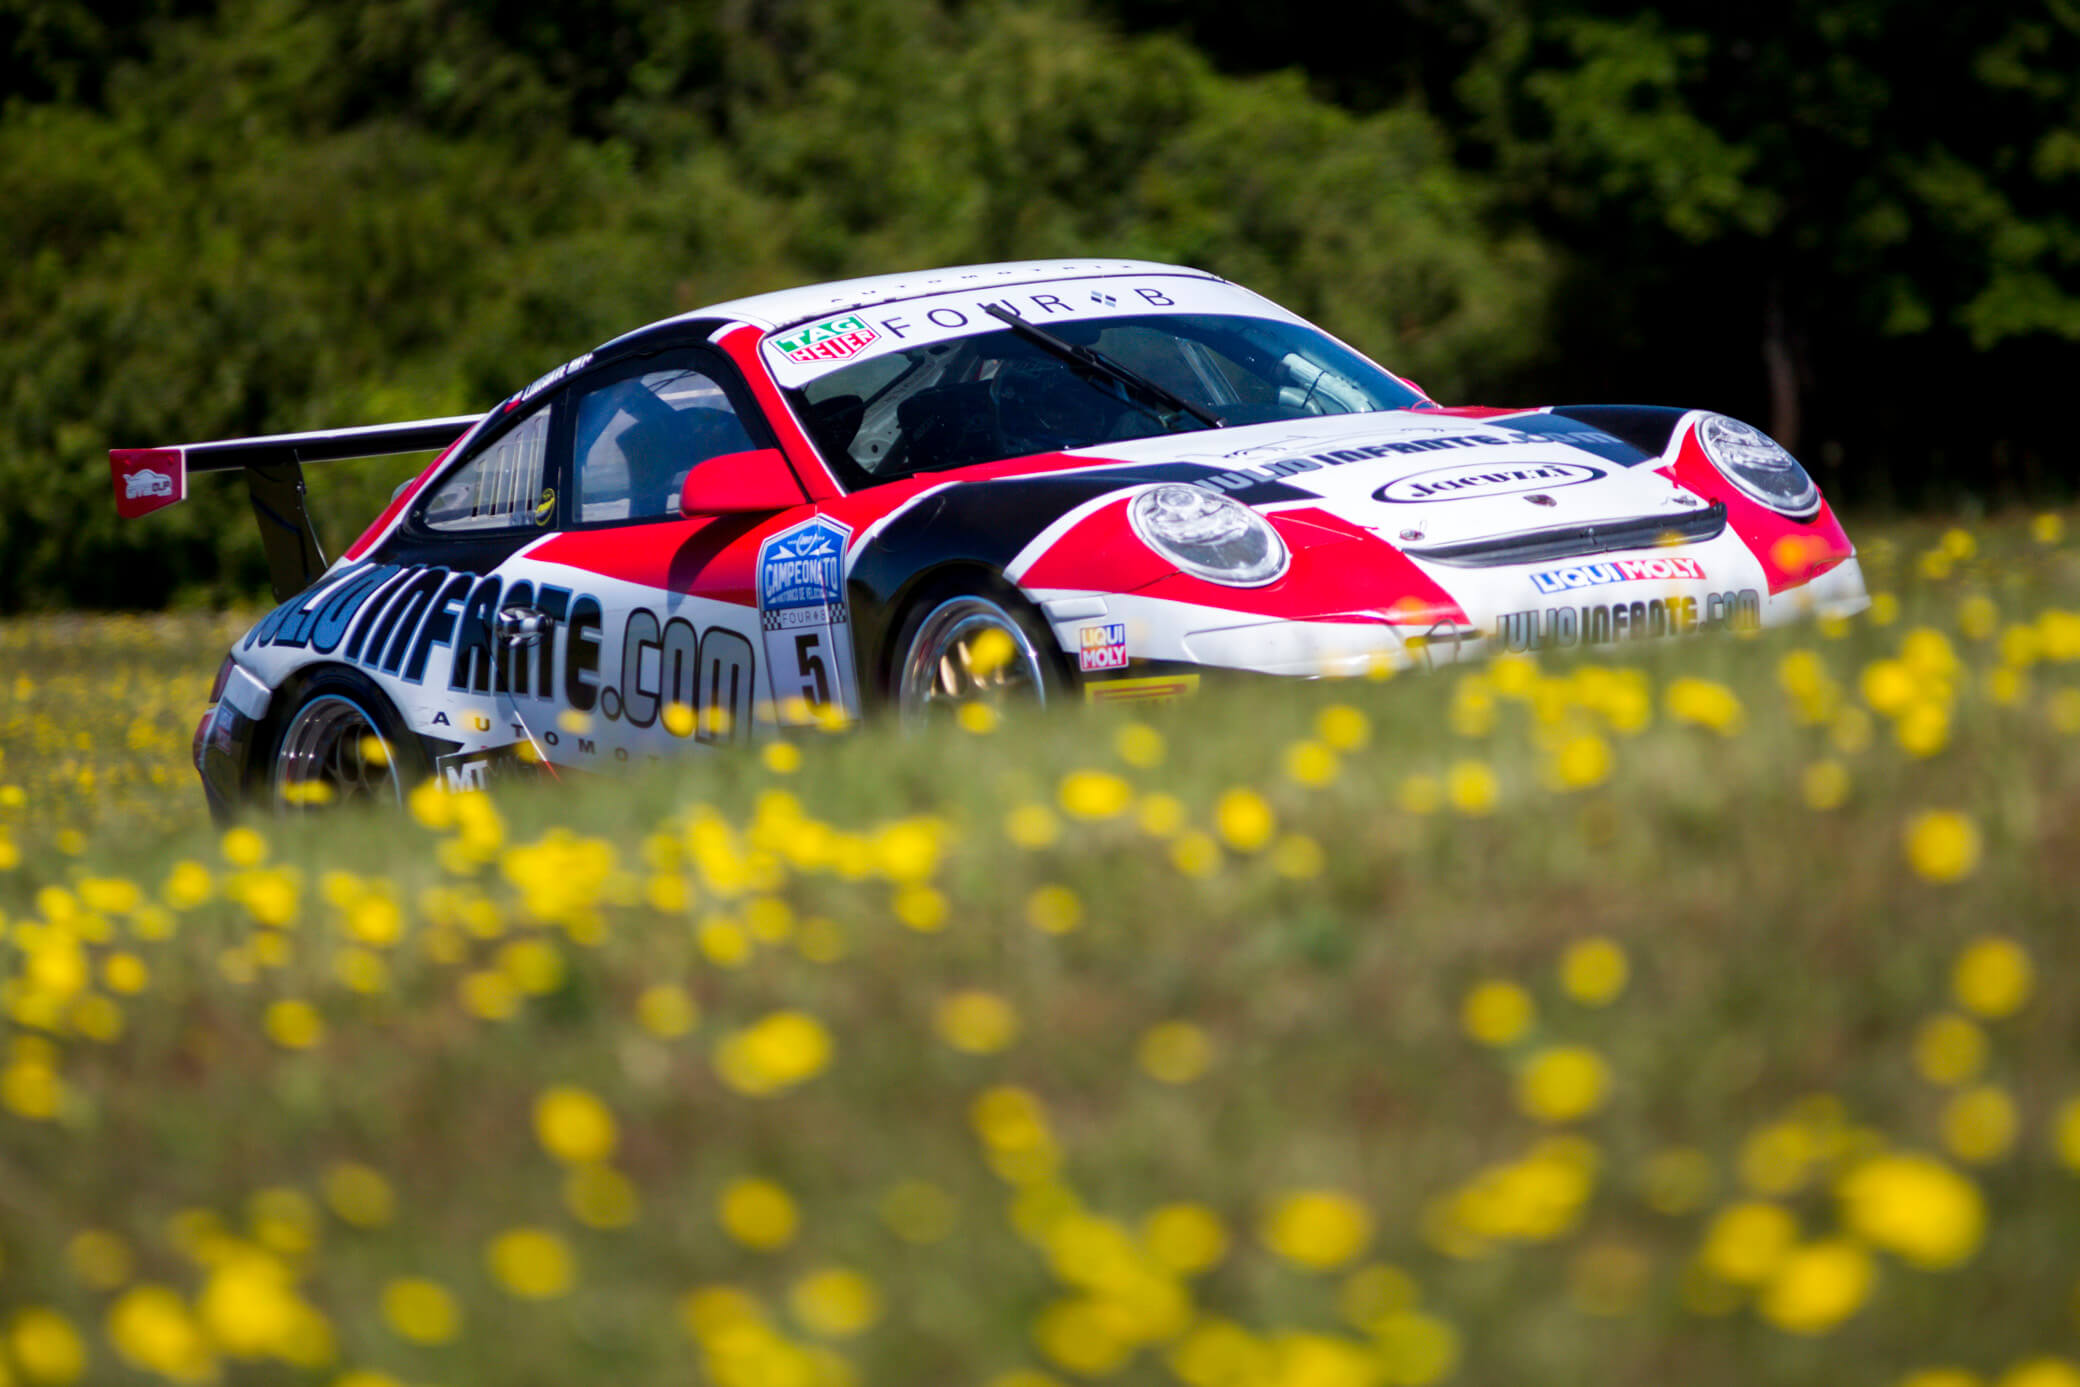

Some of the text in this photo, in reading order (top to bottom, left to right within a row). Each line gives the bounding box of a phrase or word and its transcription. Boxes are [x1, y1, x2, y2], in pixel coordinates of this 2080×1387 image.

[880, 288, 1175, 338] FOUR B
[778, 316, 860, 348] TAG
[789, 329, 876, 362] HEUER
[1409, 464, 1576, 498] Jacuzzi
[765, 556, 839, 599] CAMPEONATO
[1534, 558, 1701, 593] LIQUI MOLY
[782, 610, 812, 624] FOUR
[1081, 625, 1125, 647] LIQUI
[1082, 645, 1127, 669] MOLY
[795, 633, 832, 719] 5
